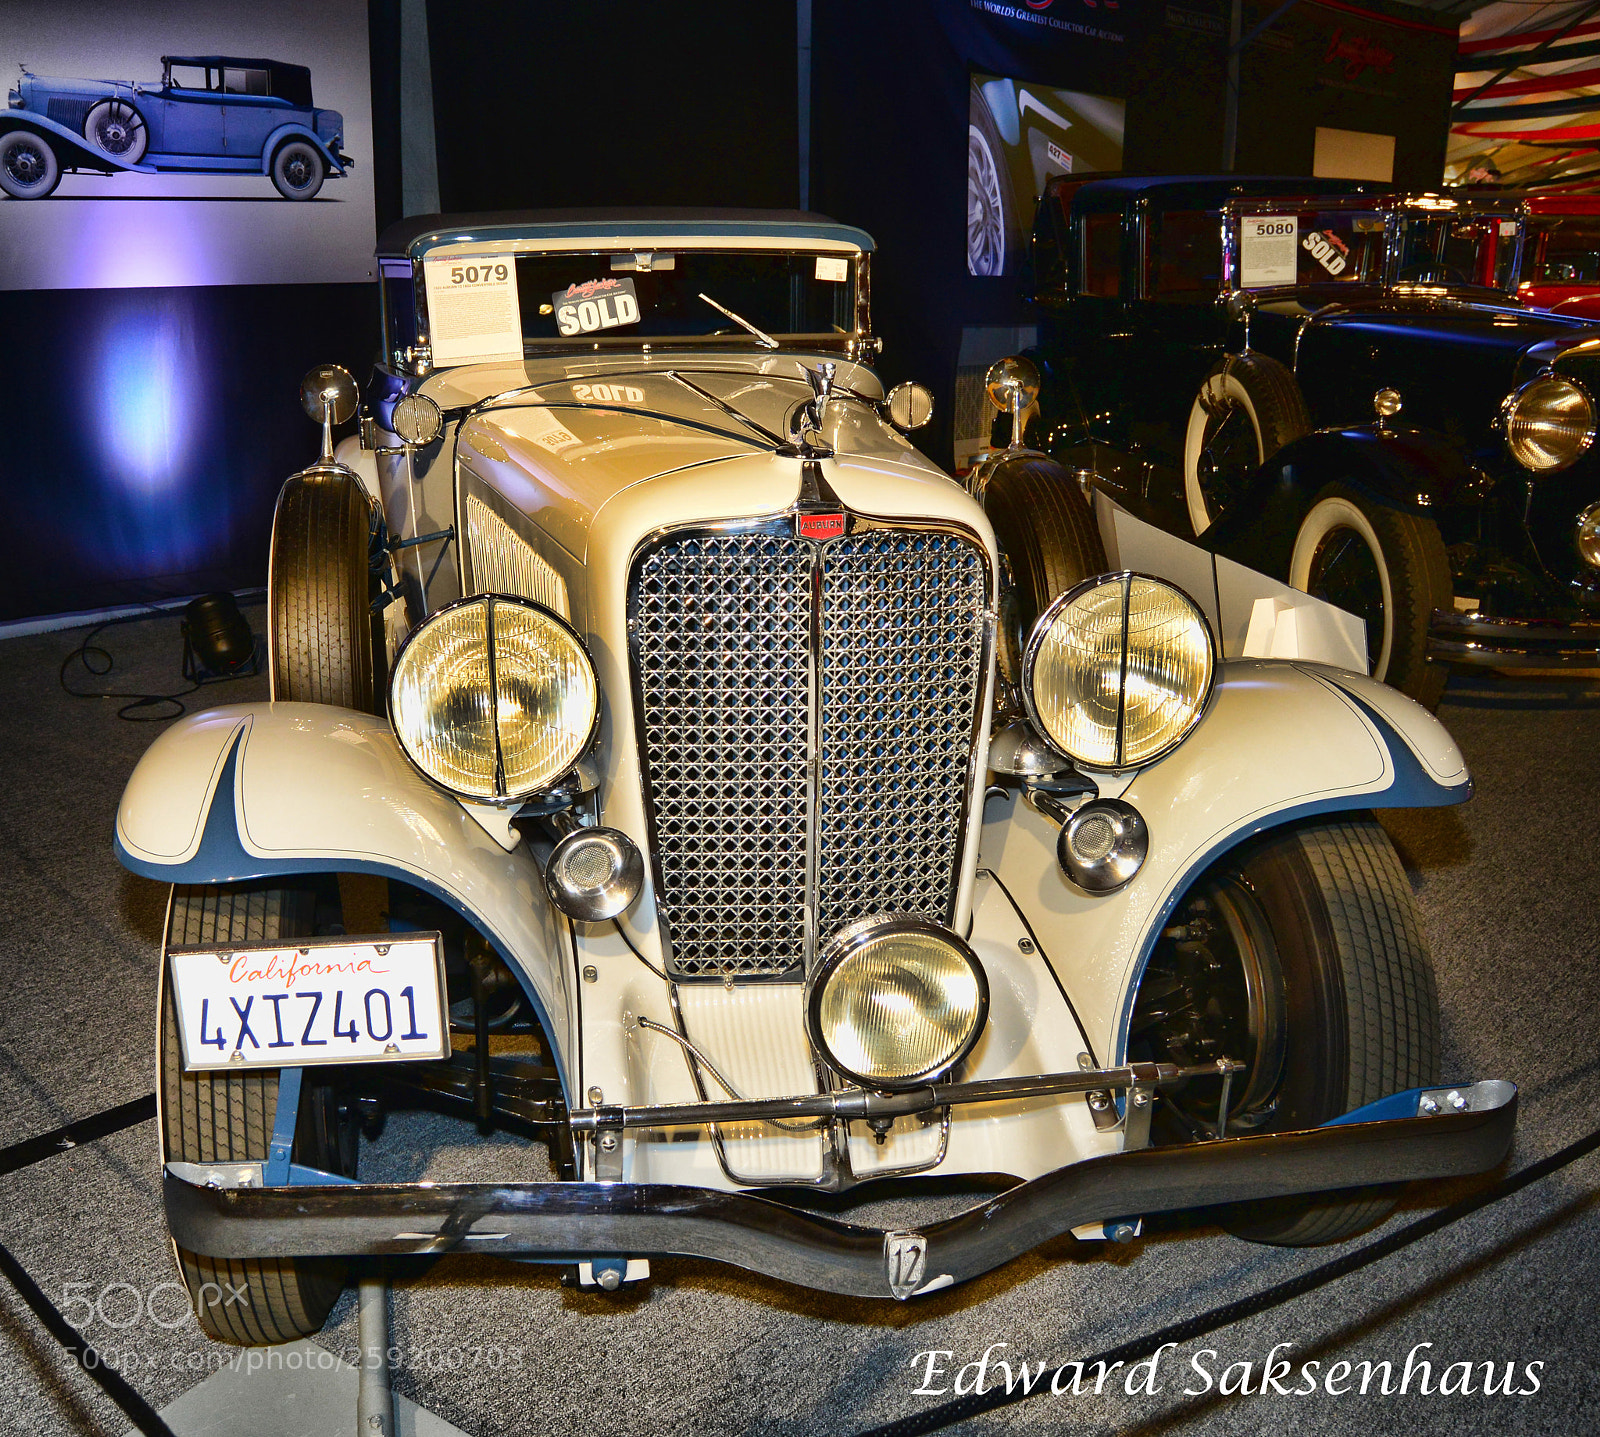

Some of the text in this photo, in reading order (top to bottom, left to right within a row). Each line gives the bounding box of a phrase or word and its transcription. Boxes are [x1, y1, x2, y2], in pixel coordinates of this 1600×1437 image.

[970, 0, 983, 10] THE
[983, 0, 1015, 17] WORLD'S
[1016, 8, 1048, 26] GREATEST
[1048, 16, 1085, 34] COLLECTOR
[1085, 25, 1098, 37] CAR
[1256, 223, 1293, 236] 5080
[1302, 231, 1346, 276] SOLD
[451, 264, 508, 284] 5079
[558, 294, 637, 335] SOLD
[802, 520, 842, 530] AUBURN
[229, 952, 390, 988] California
[200, 985, 428, 1051] 4XIZ401
[894, 1244, 921, 1287] 12
